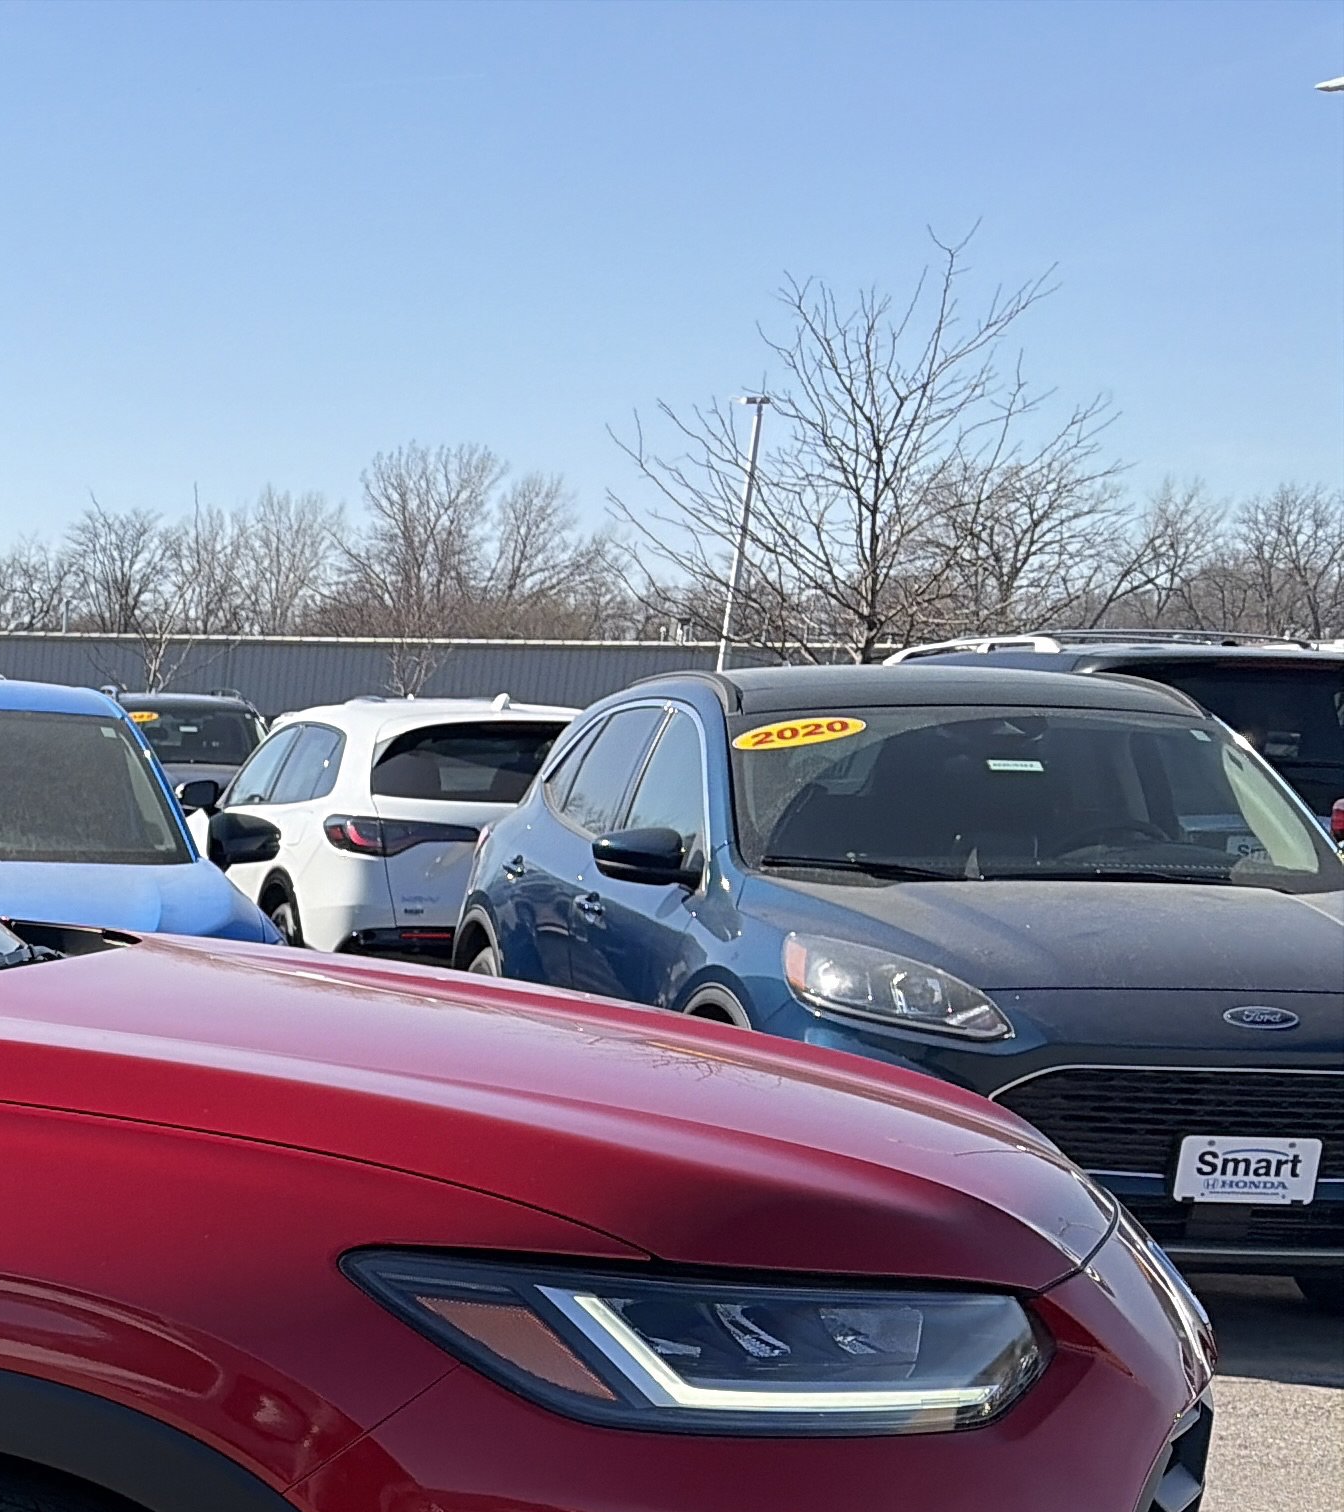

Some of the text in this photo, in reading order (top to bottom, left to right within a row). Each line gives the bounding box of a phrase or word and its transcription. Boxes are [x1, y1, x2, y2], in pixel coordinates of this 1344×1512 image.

[751, 719, 849, 747] 2020
[1243, 1008, 1282, 1022] Ford
[1195, 1150, 1303, 1178] Smart
[1219, 1179, 1289, 1190] HONDA
